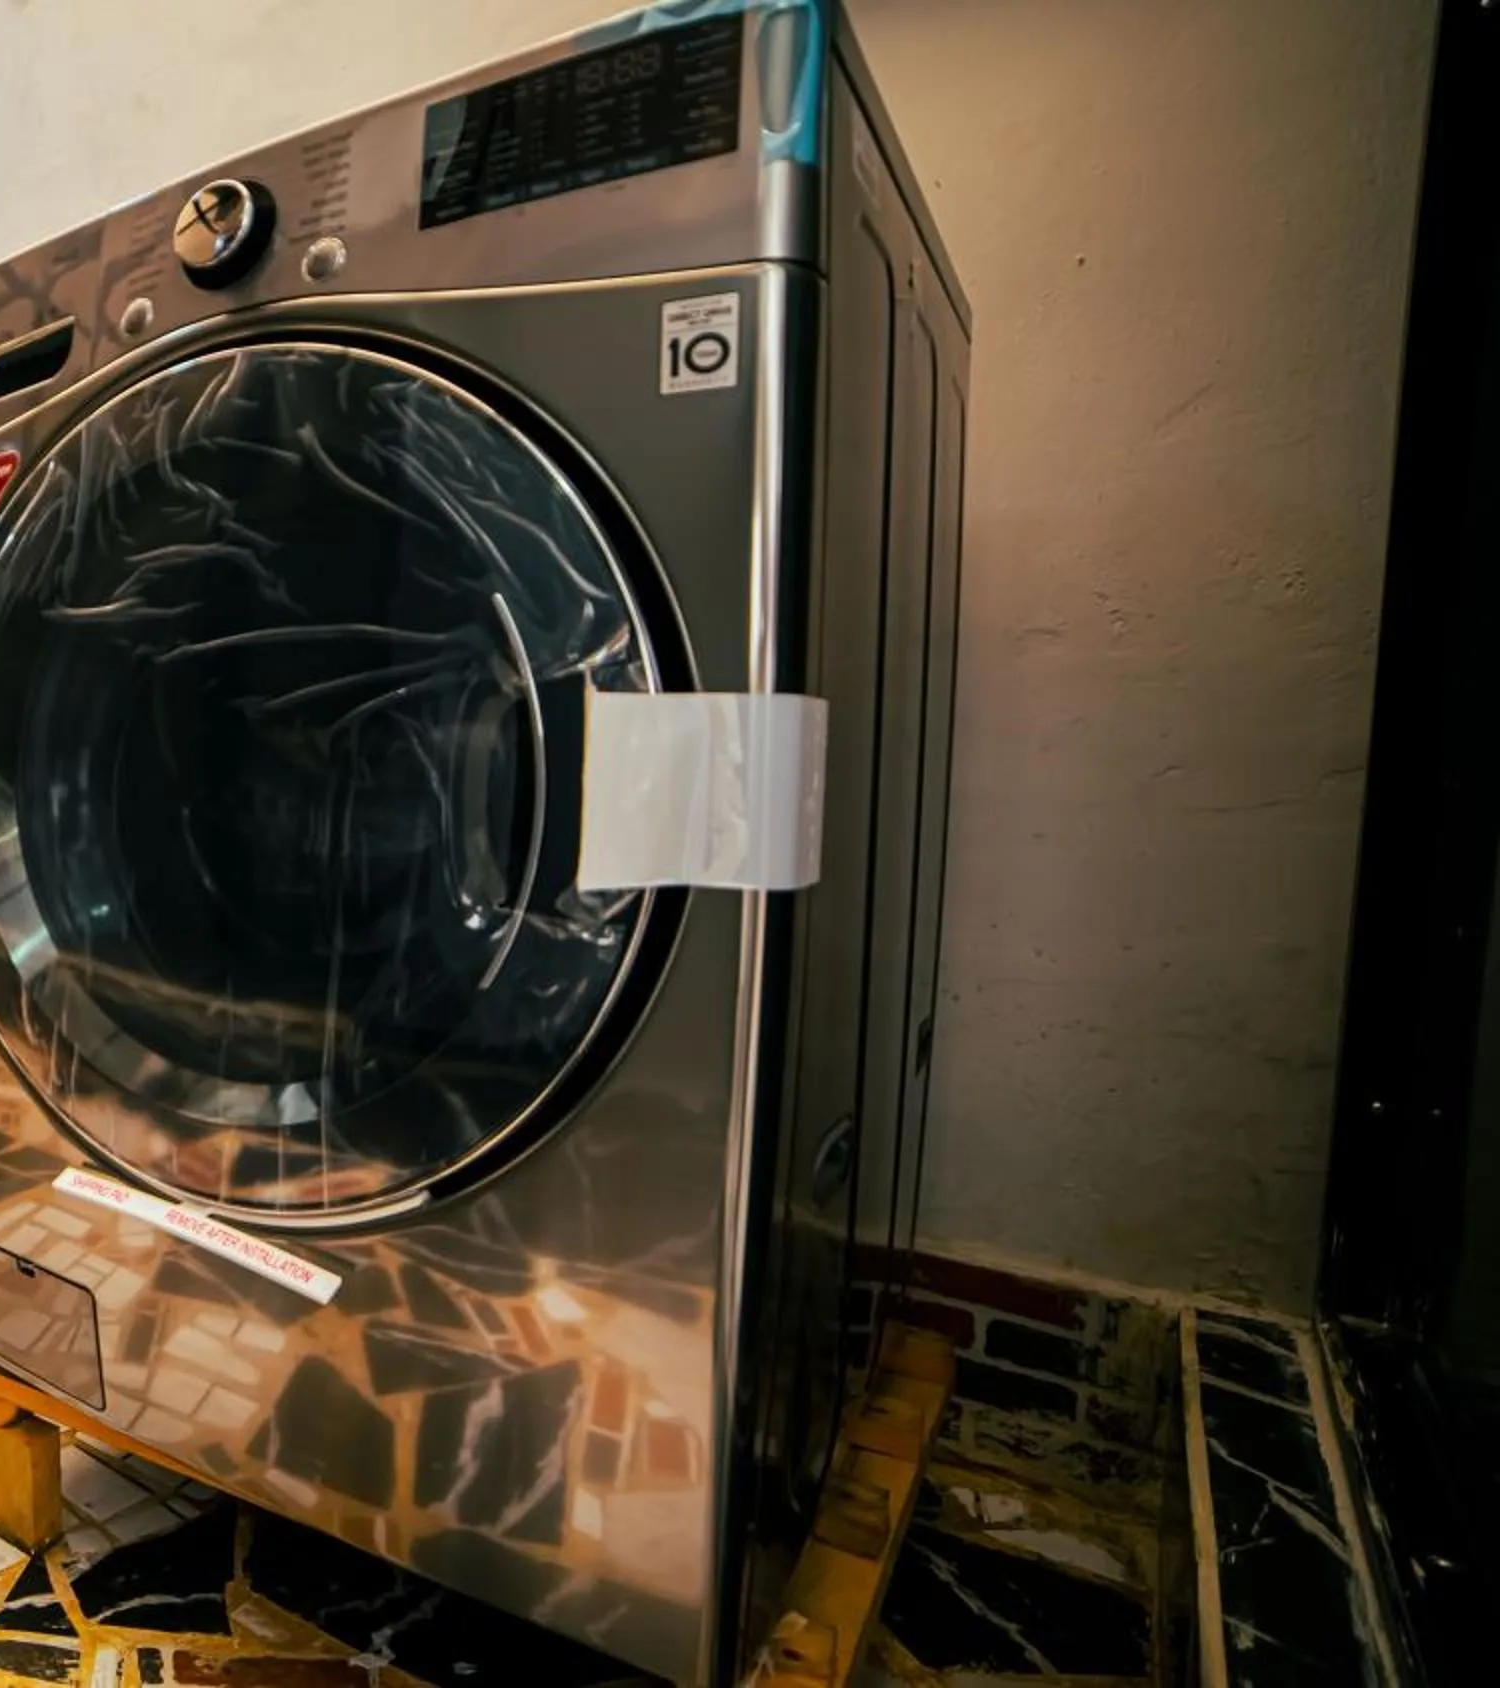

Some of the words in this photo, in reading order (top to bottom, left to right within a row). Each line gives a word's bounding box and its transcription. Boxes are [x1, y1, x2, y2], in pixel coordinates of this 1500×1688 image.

[669, 331, 731, 378] 10
[165, 1209, 204, 1234] REMOVE
[207, 1225, 241, 1248] AFTER
[238, 1242, 313, 1283] INSTALLATION
